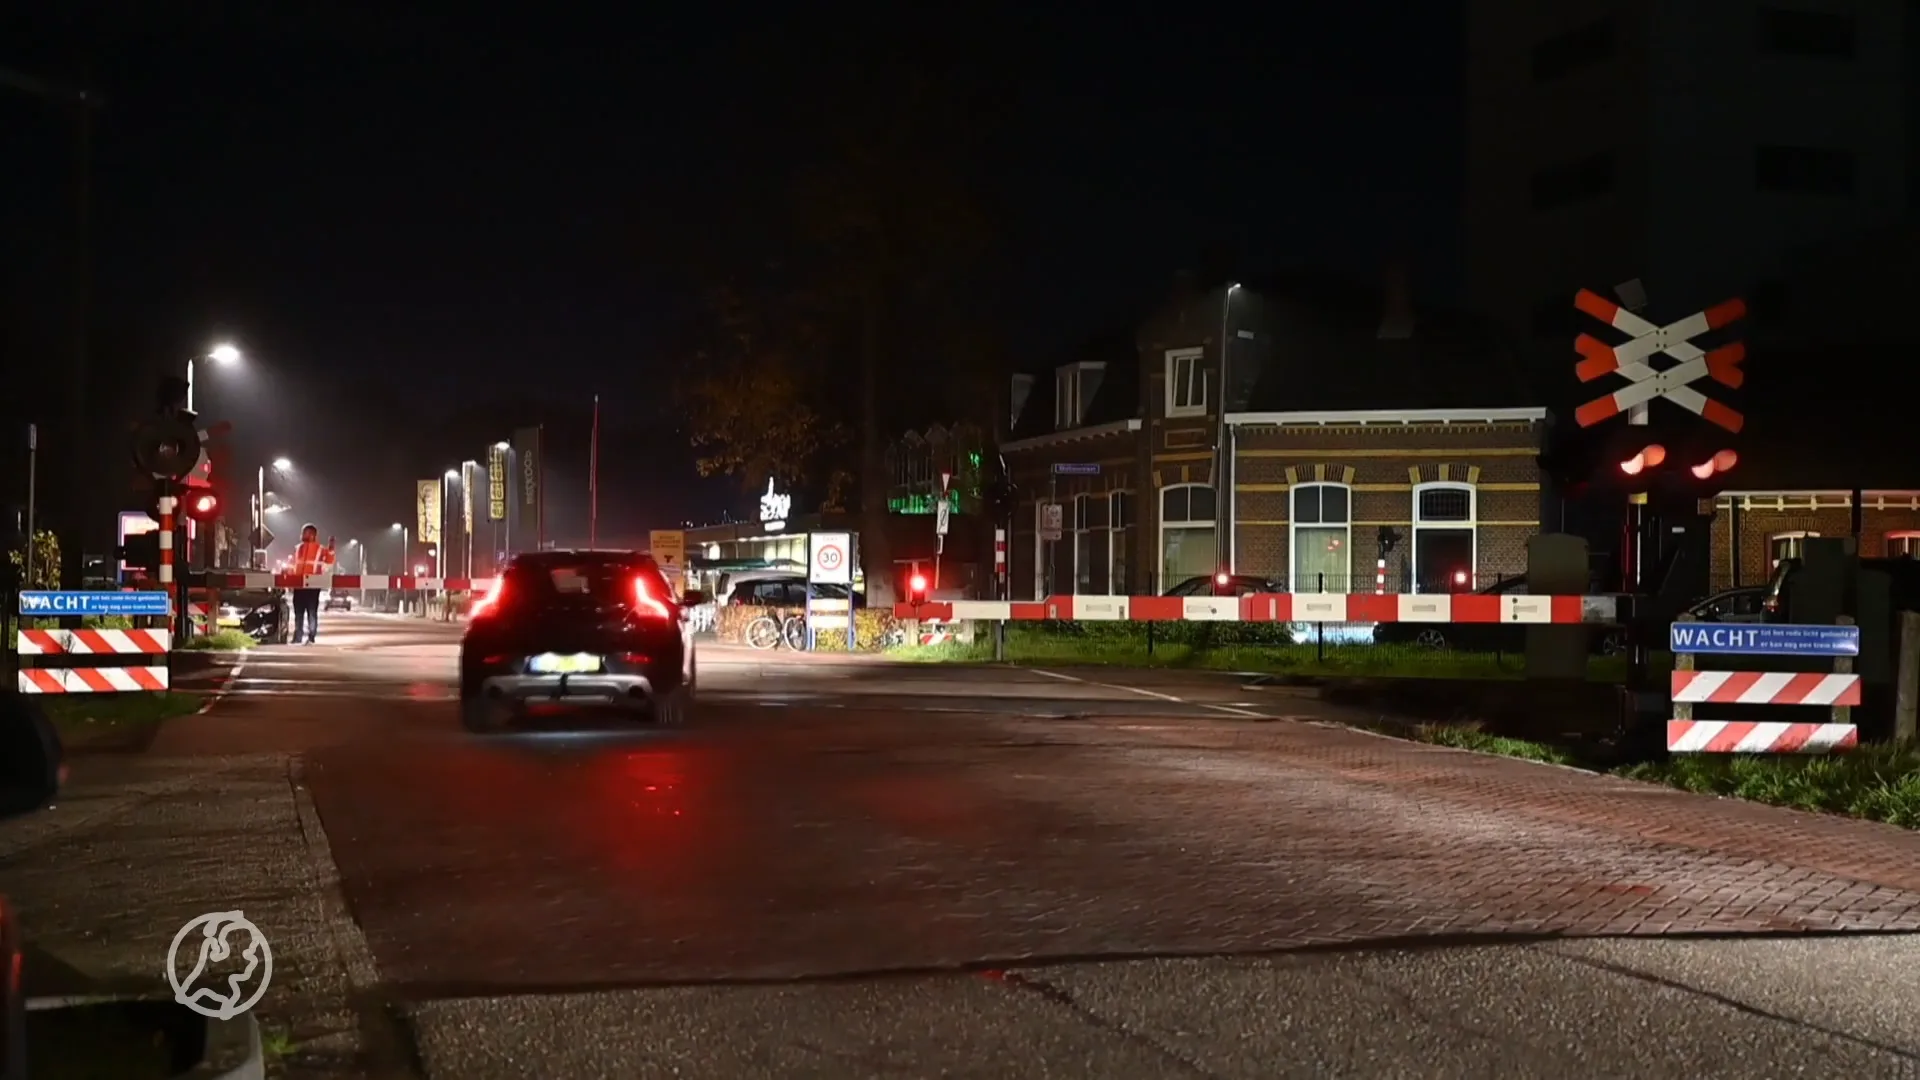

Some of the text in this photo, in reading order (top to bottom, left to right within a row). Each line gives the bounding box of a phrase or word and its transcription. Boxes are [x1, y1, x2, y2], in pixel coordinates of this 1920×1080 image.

[823, 552, 838, 563] 30
[22, 595, 90, 610] WACHT
[1673, 628, 1758, 647] WACHT
[1783, 642, 1798, 650] nog
